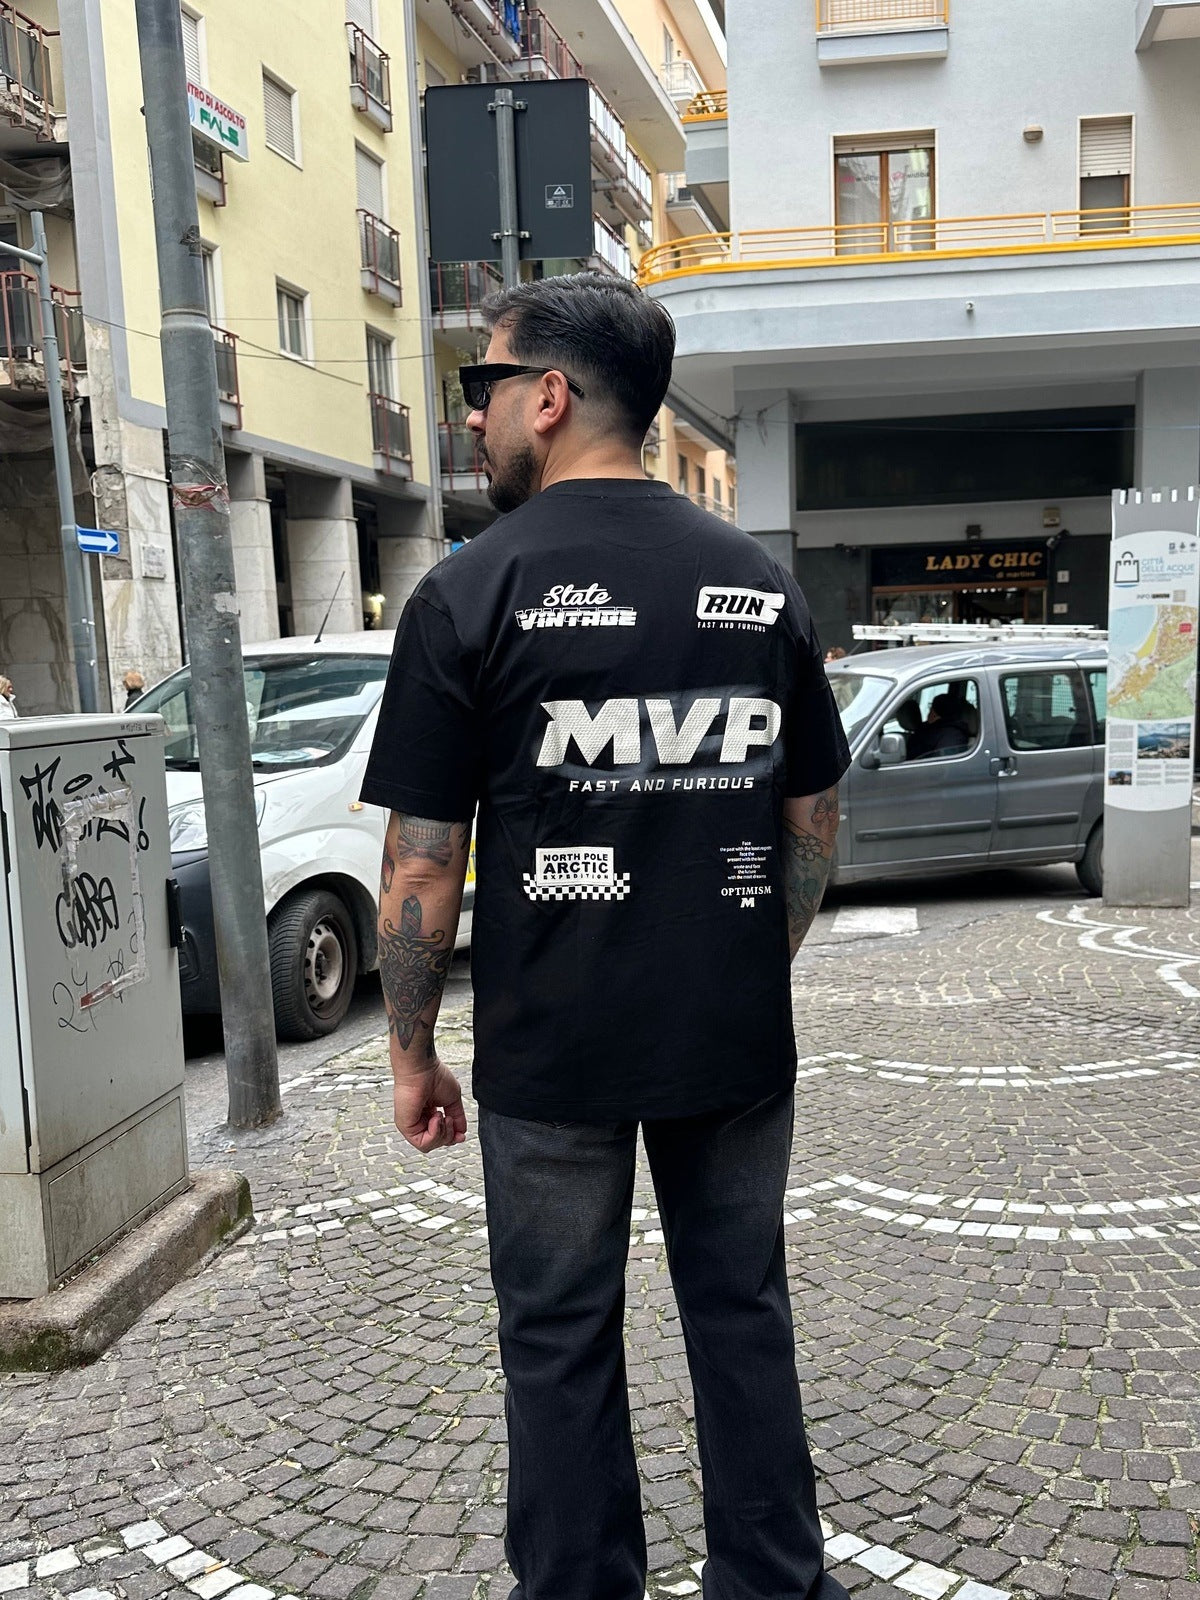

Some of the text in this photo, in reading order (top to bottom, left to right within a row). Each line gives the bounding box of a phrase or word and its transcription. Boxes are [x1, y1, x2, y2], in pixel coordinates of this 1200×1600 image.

[206, 95, 213, 108] DI
[215, 102, 245, 129] ASCOLTO
[926, 552, 1043, 571] LADY CHIC
[1141, 564, 1195, 573] DELLE ACQUE
[542, 582, 612, 607] State
[703, 593, 765, 617] RUN
[515, 607, 637, 631] VINTAGE
[697, 621, 716, 629] FAST
[738, 622, 766, 632] FURIOUS
[536, 697, 782, 767] MVP
[569, 777, 755, 793] FAST AND FURIOUS
[543, 853, 608, 862] NORTH POLE
[543, 862, 608, 874] ARCTIC
[721, 886, 772, 896] OPTIMISM
